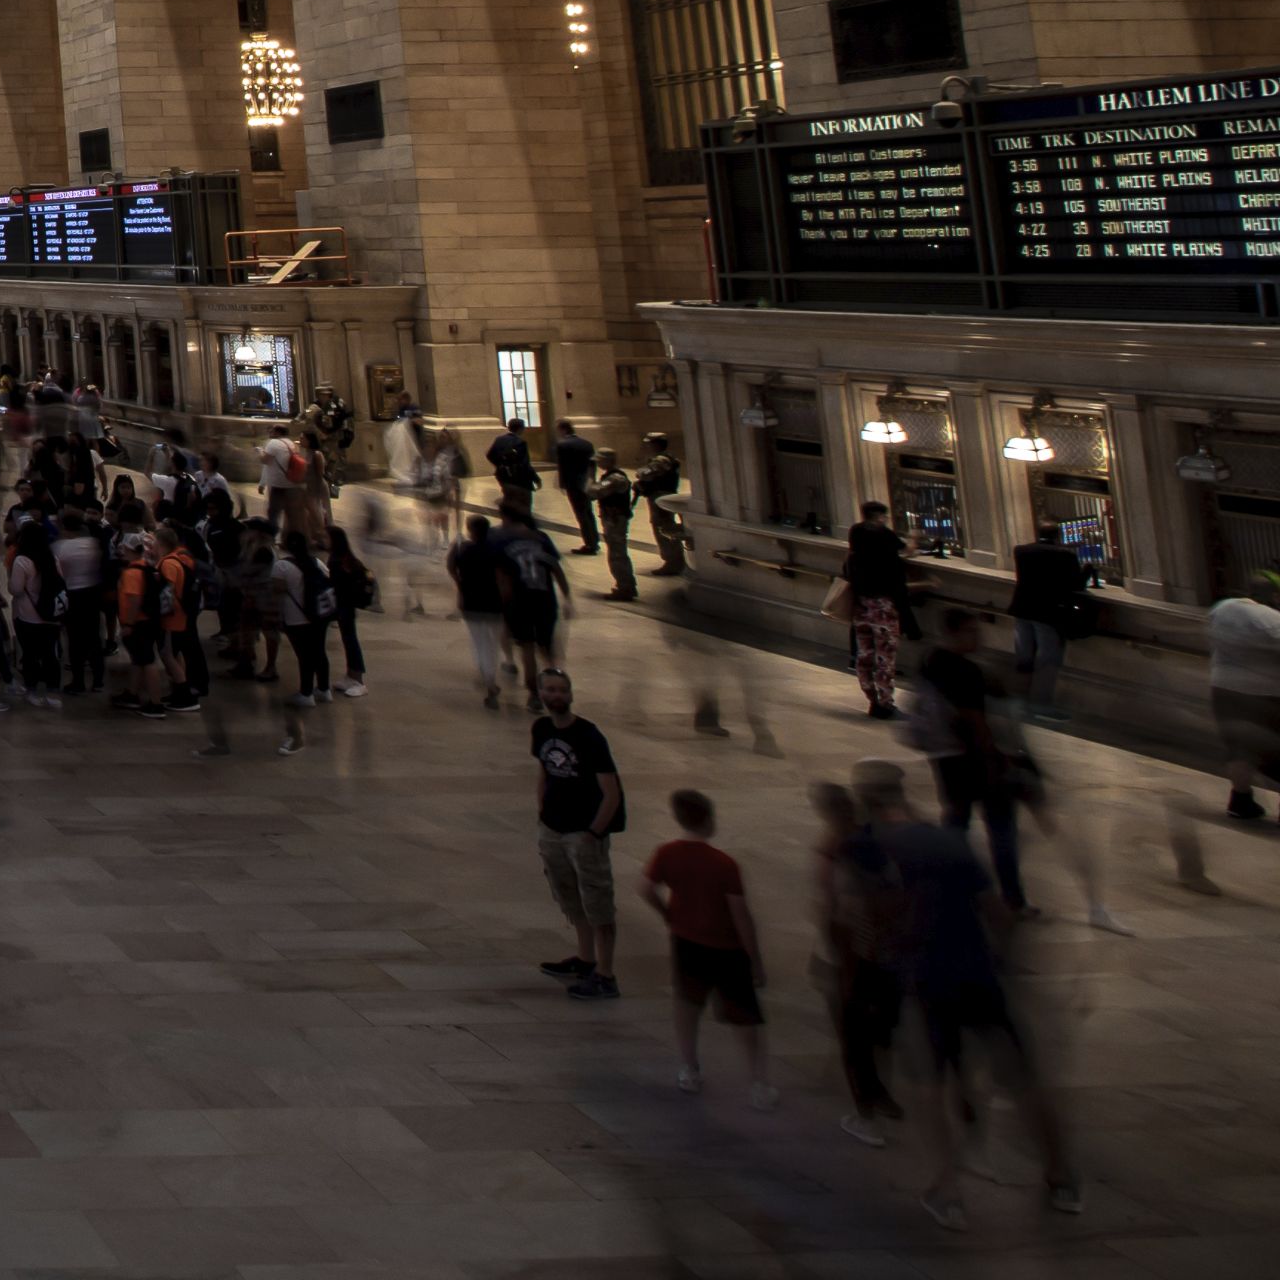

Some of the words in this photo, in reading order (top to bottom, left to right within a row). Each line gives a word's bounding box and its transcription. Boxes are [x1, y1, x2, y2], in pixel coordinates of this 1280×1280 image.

[1099, 87, 1193, 111] HARLEM
[1198, 81, 1254, 103] LINE
[1259, 78, 1280, 97] D
[810, 112, 924, 137] INFORMATION
[995, 136, 1032, 151] TIME
[1041, 133, 1076, 148] TRK
[1084, 124, 1197, 145] DESTINATION
[1223, 118, 1280, 135] REMA
[815, 151, 865, 165] Attention
[1009, 159, 1038, 173] 3:56
[1058, 157, 1078, 170] 111
[1092, 155, 1107, 167] N.
[1114, 152, 1153, 167] WHITE
[1159, 148, 1209, 164] PLAINS
[819, 171, 846, 182] leave
[900, 164, 961, 178] unattended
[1012, 180, 1041, 194] 3:58
[1061, 178, 1083, 192] 108
[1095, 176, 1110, 190] N.
[1116, 173, 1156, 189] WHITE
[1162, 171, 1212, 187] PLAINS
[1234, 168, 1280, 184] MELRO
[880, 189, 898, 201] may
[903, 187, 916, 199] be
[920, 185, 964, 197] removed
[802, 210, 813, 222] By
[819, 209, 834, 220] the
[838, 208, 855, 219] MTA
[860, 207, 895, 219] Police
[900, 205, 960, 219] Department
[1015, 202, 1044, 215] 4:19
[1064, 200, 1086, 213] 105
[1098, 196, 1167, 212] SOUTHEAST
[800, 228, 826, 240] Thank
[830, 229, 848, 240] you
[853, 227, 869, 239] for
[874, 229, 897, 240] your
[903, 225, 970, 239] cooperation
[1018, 223, 1047, 236] 4:22
[1102, 220, 1170, 235] SOUTHEAST
[1242, 217, 1280, 232] WHIT
[1021, 244, 1050, 258] 4:25
[1104, 245, 1119, 258] N.
[1127, 243, 1167, 258] WHITE
[1172, 241, 1223, 257] PLAINS
[251, 303, 286, 312] SERVICE
